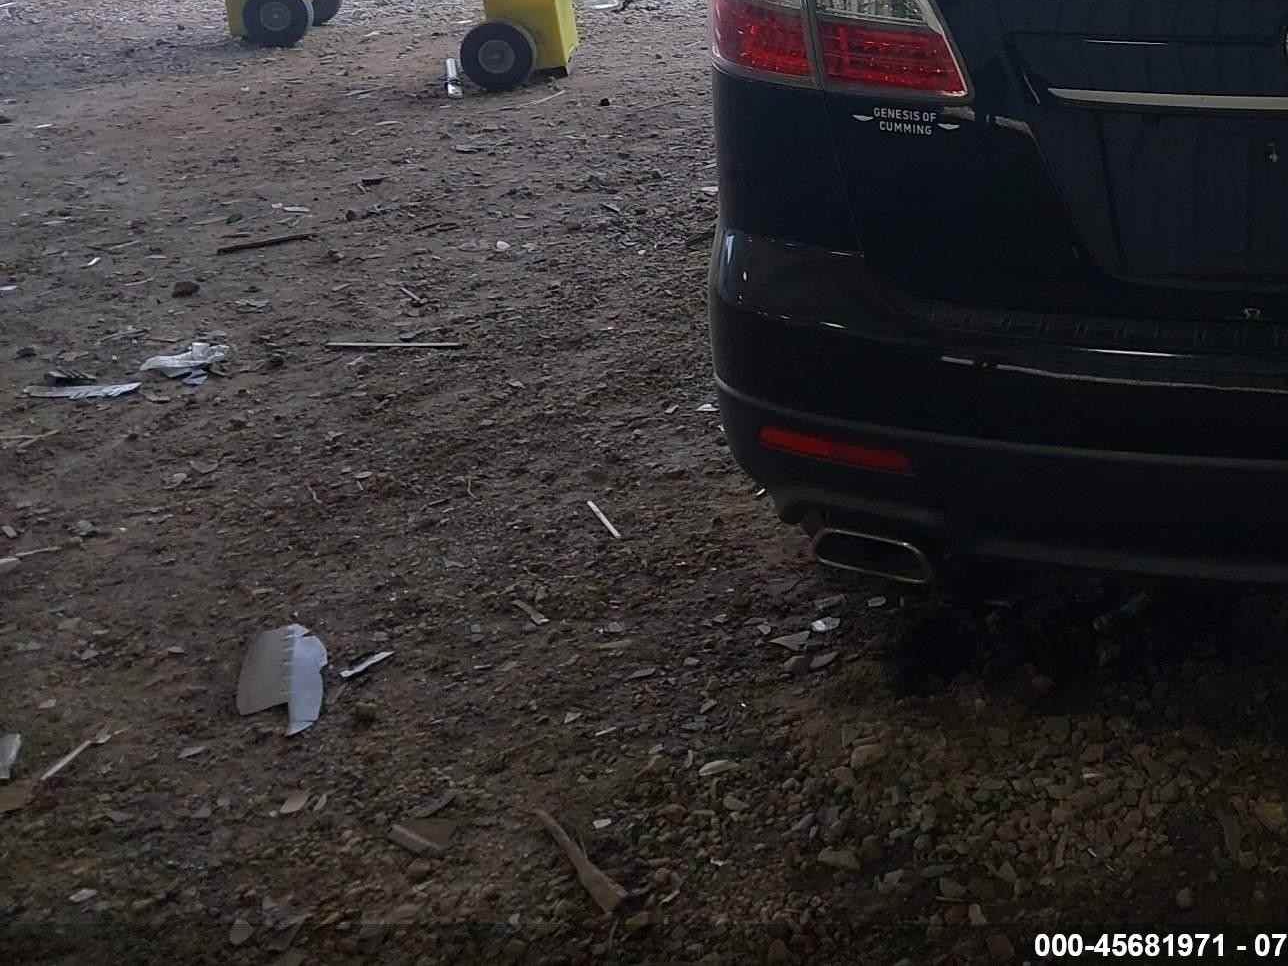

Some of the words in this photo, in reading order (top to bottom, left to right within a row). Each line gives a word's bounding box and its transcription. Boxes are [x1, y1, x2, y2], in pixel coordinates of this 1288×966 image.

[873, 108, 920, 122] GENESIS
[922, 112, 937, 123] OF
[879, 121, 932, 136] CUMMING
